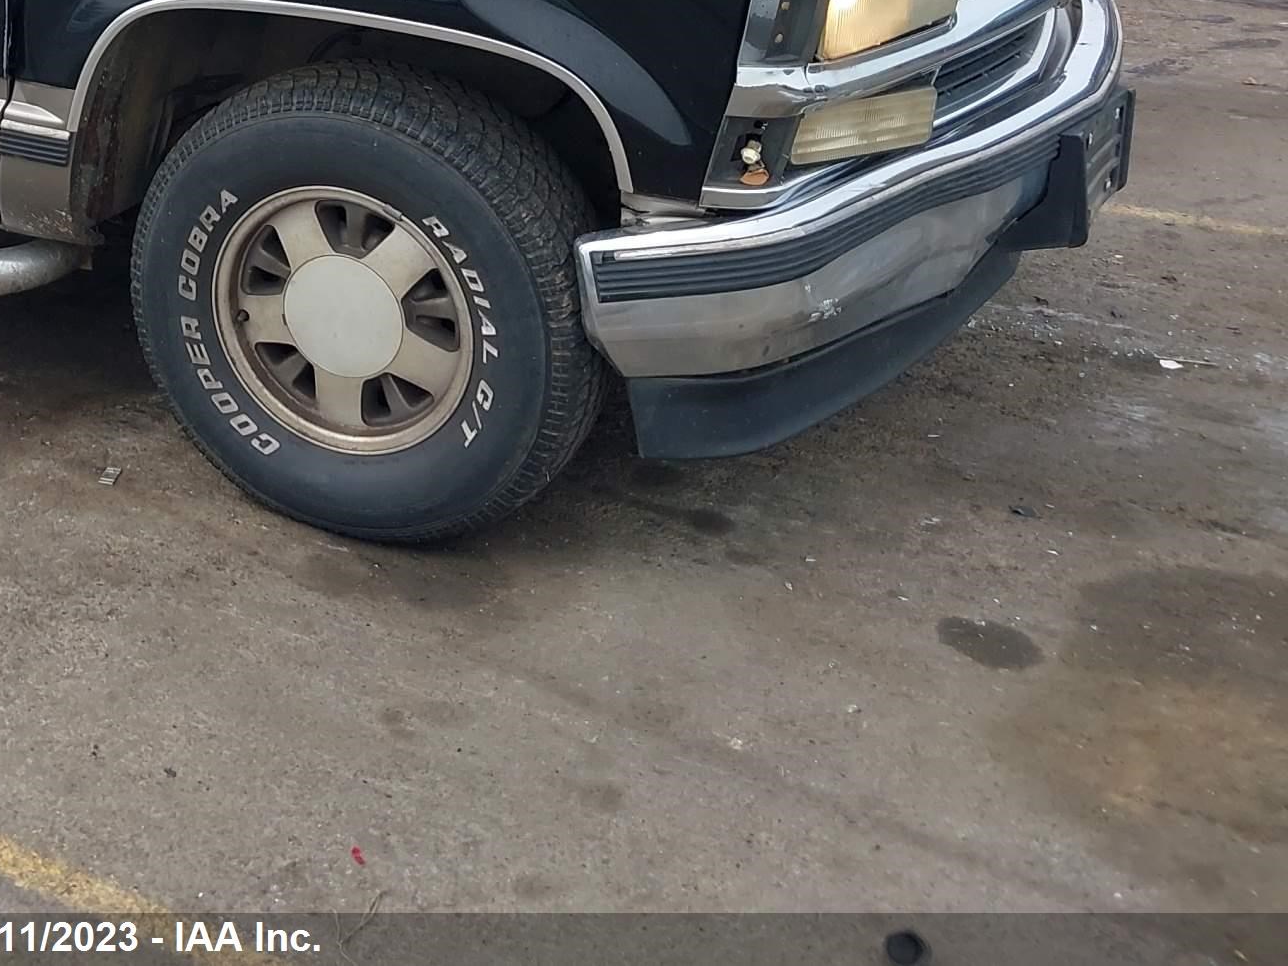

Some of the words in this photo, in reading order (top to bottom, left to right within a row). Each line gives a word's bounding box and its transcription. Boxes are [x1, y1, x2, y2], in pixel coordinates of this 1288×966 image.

[178, 189, 239, 301] COBRA
[422, 216, 499, 364] RADIAL
[180, 314, 281, 455] COOPER
[461, 378, 495, 449] G/T
